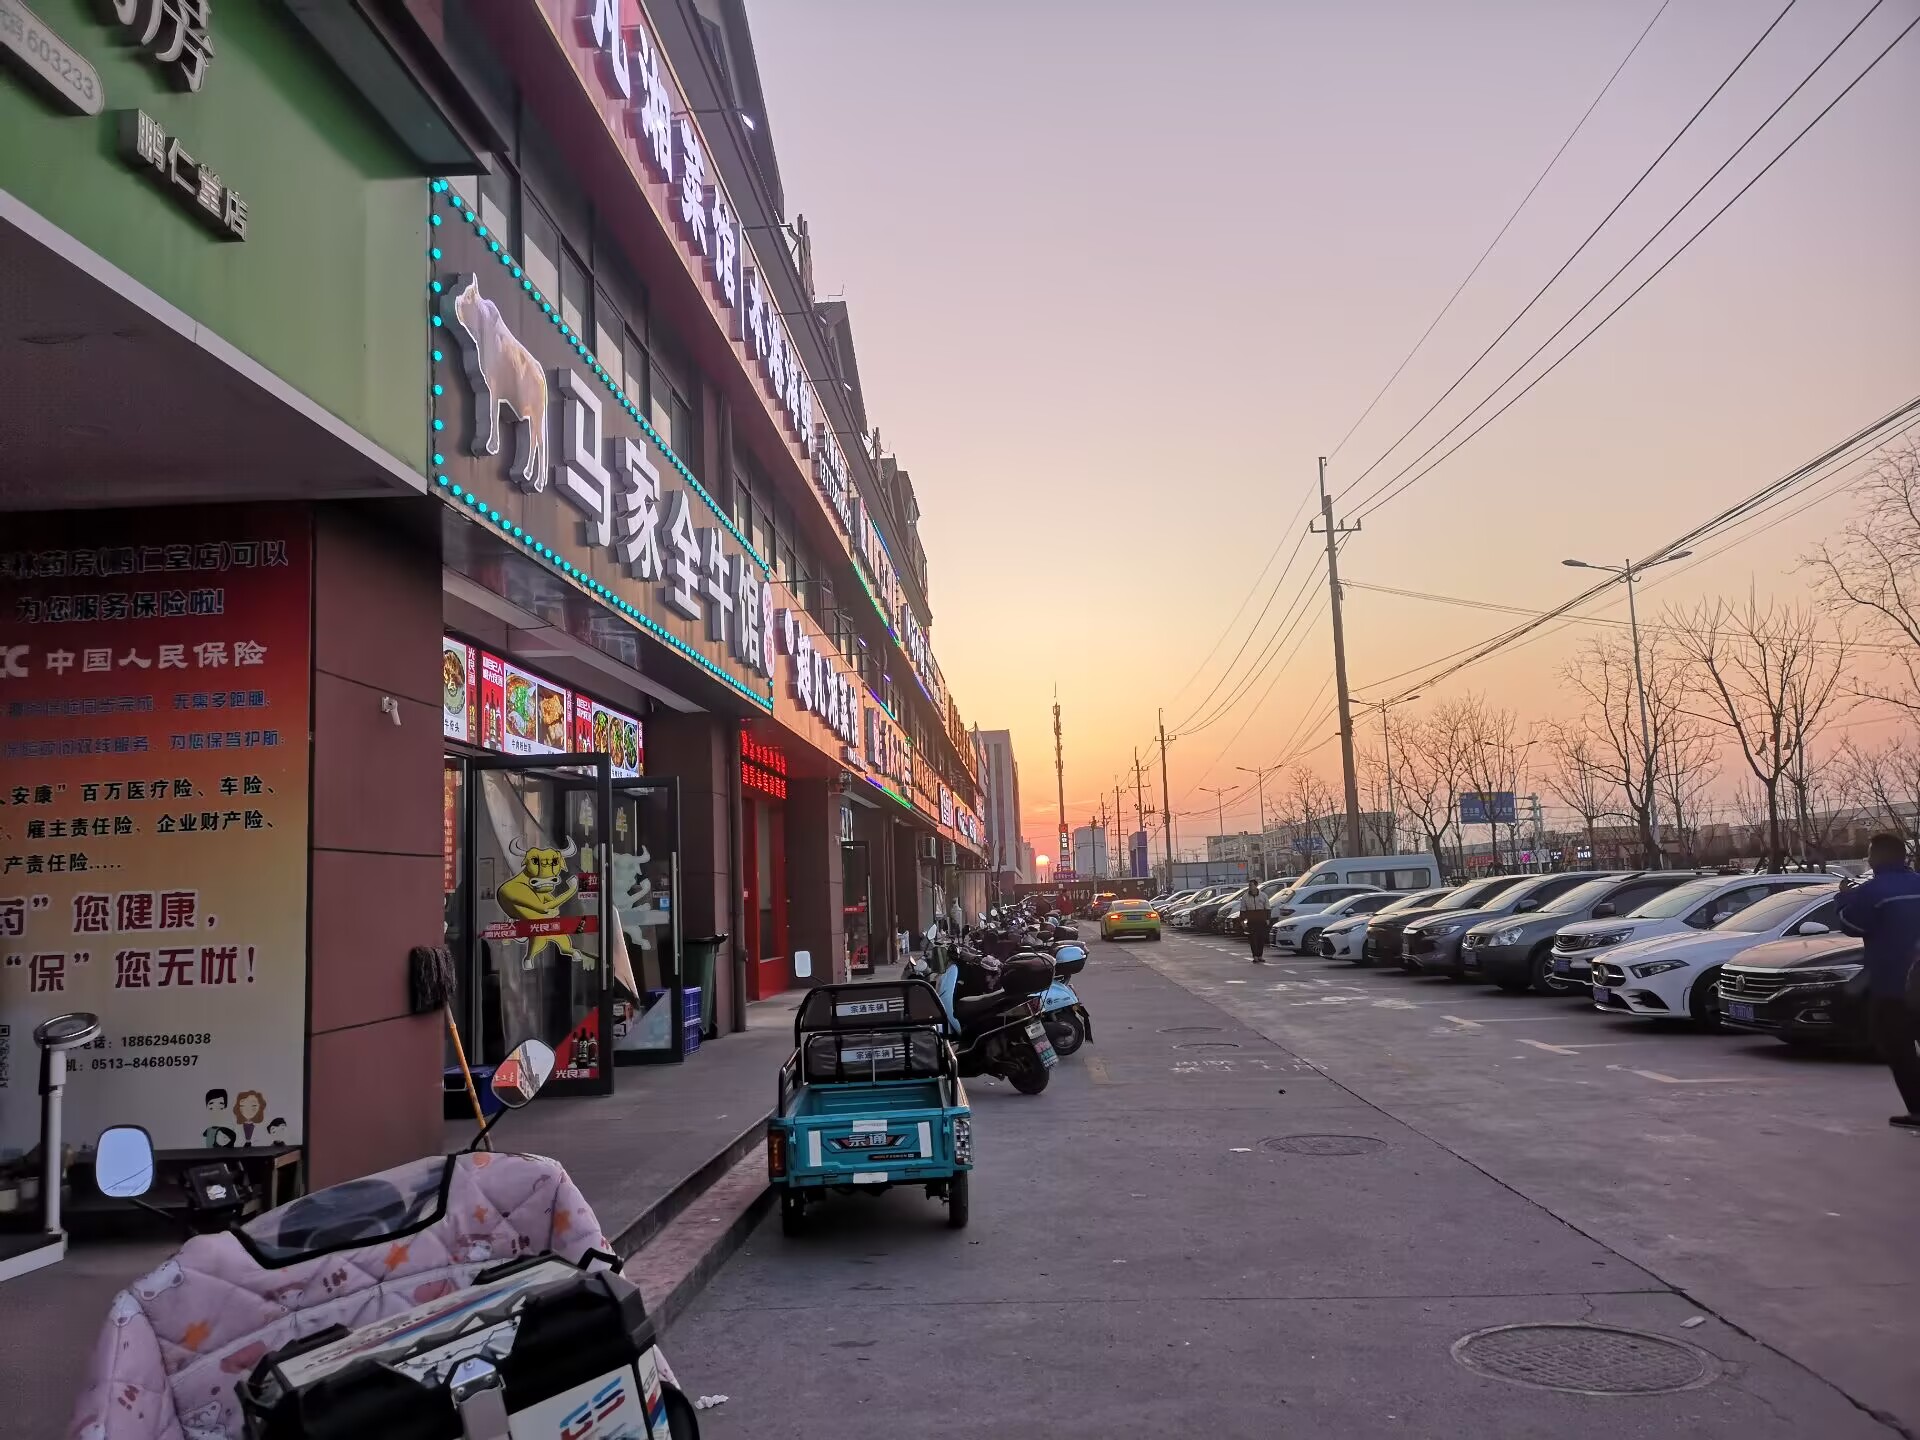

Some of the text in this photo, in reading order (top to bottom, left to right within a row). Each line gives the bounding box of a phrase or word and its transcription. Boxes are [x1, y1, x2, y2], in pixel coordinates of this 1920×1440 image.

[27, 28, 95, 101] 603233
[136, 108, 248, 241] 鹏仁堂店
[563, 367, 760, 670] 马家全牛馆
[46, 640, 268, 676] 中国人民保险
[588, 874, 598, 886] 拉
[121, 1033, 211, 1047] 18862946038
[92, 1055, 199, 1070] 0513-84680597
[848, 1132, 887, 1147] 宗通
